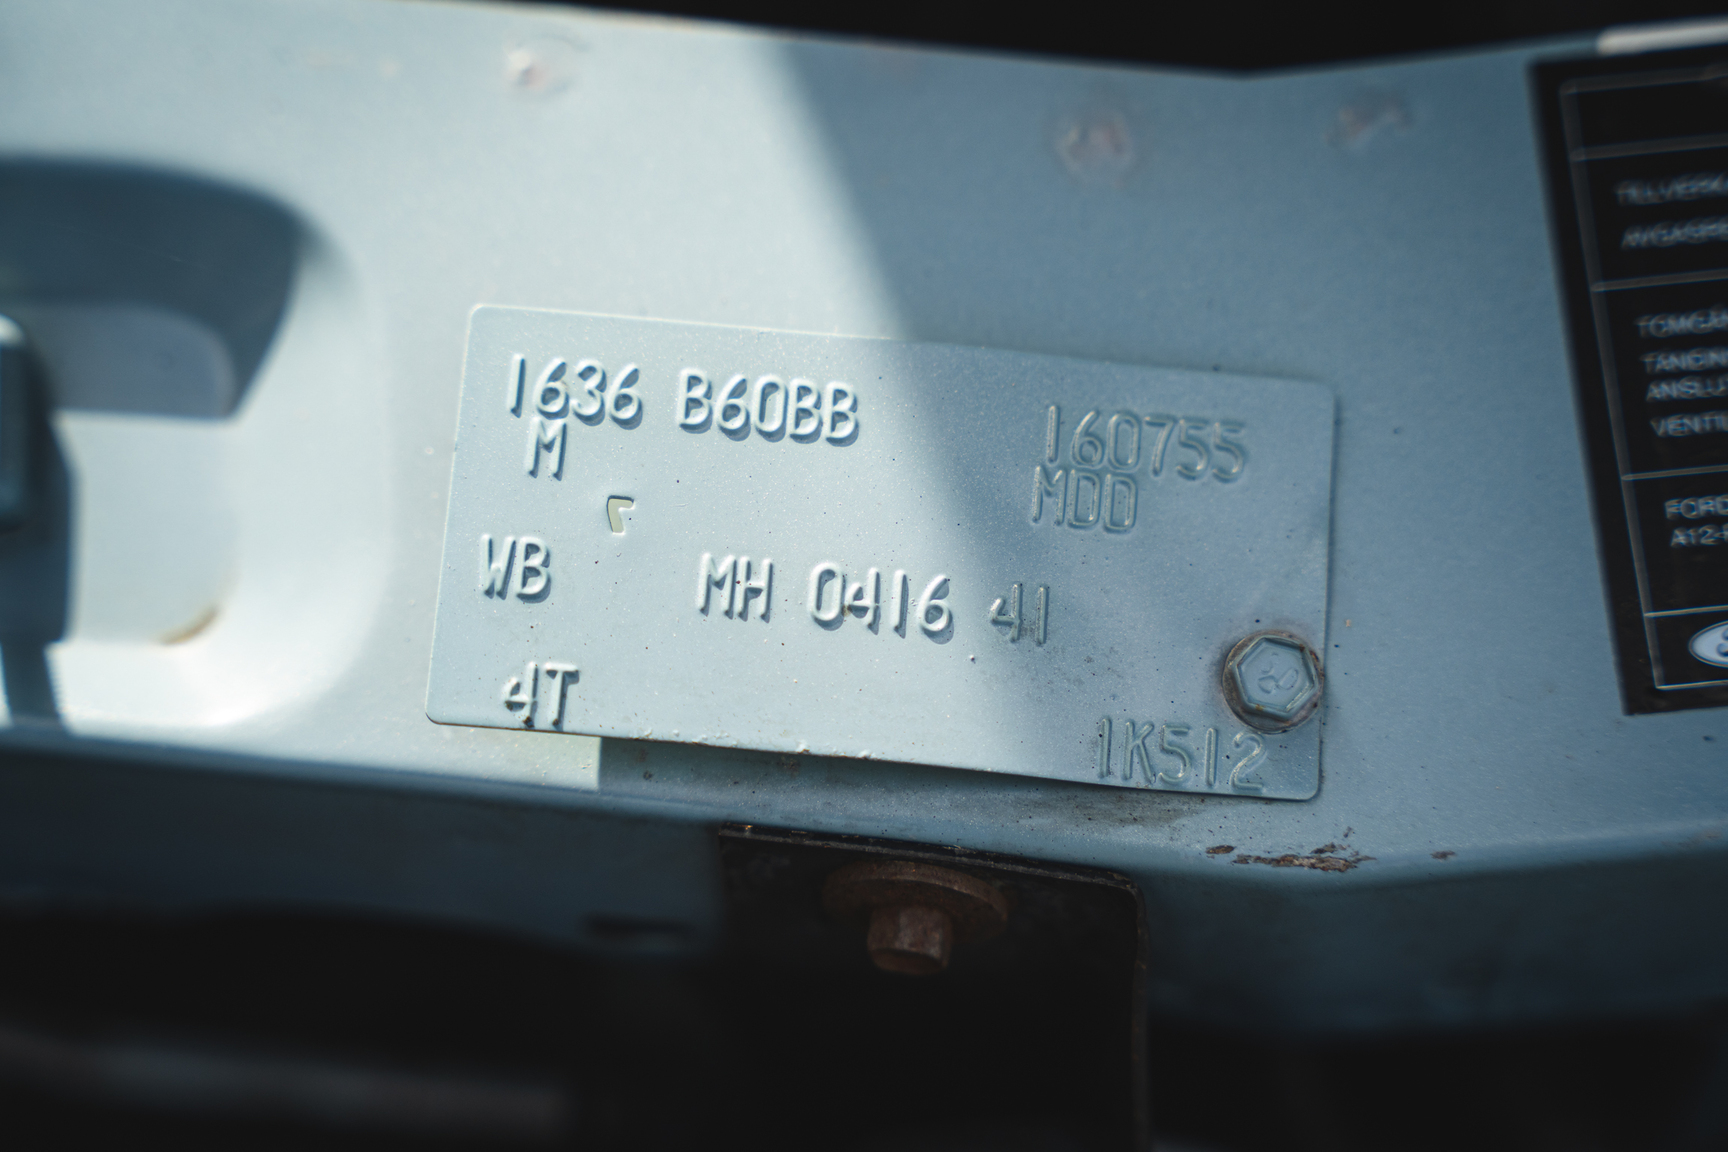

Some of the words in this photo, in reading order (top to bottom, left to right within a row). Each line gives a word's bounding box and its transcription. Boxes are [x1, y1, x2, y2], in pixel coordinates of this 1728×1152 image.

[508, 353, 643, 429] 1636
[679, 367, 859, 447] B60BB
[1044, 404, 1248, 482] 160755
[525, 416, 568, 481] M
[1031, 464, 1139, 533] MDD
[480, 533, 552, 602] WB
[697, 552, 775, 622] MH
[808, 561, 955, 644] 0416
[989, 582, 1050, 646] 41
[1098, 716, 1268, 792] 1K512
